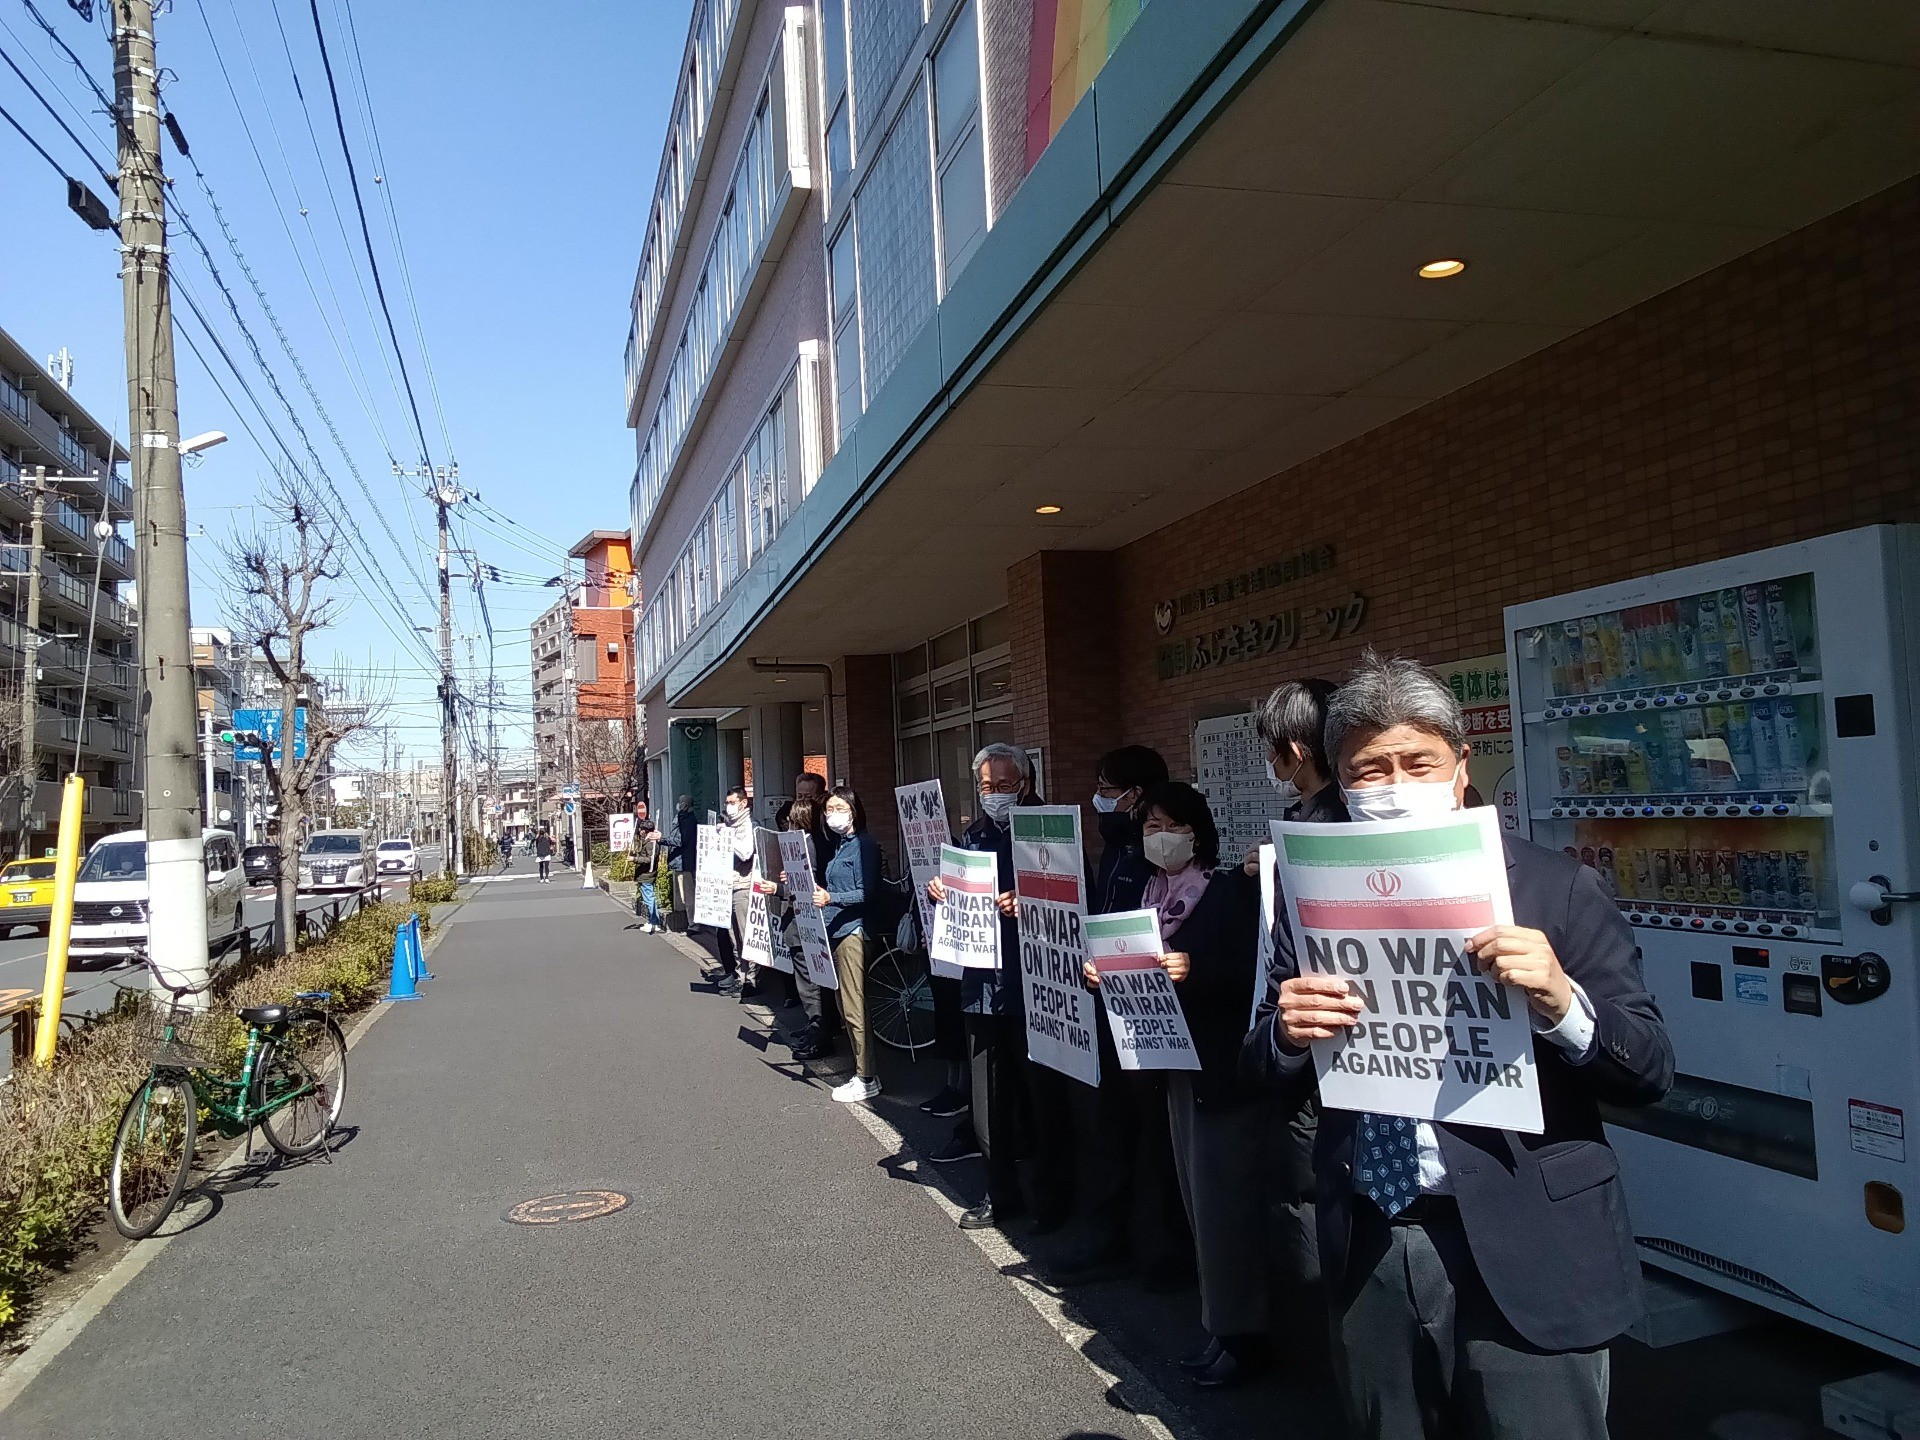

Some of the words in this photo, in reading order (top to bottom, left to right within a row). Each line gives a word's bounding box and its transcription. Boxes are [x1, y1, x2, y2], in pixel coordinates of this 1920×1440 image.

[943, 888, 955, 906] NO
[958, 893, 993, 911] WAR
[750, 911, 766, 927] ON
[941, 906, 955, 923] ON
[958, 910, 995, 928] IRAN
[1020, 902, 1040, 938] NO
[1041, 906, 1081, 949] WAR
[938, 936, 970, 952] AGAINST
[972, 944, 996, 954] WAR
[946, 924, 986, 943] PEOPLE
[1023, 941, 1043, 978] ON
[1045, 946, 1086, 990] IRAN
[1305, 937, 1369, 976] NO
[1100, 975, 1126, 995] NO
[1125, 972, 1170, 994] WAR
[1032, 982, 1080, 1024] PEOPLE
[1110, 996, 1136, 1016] ON
[1137, 995, 1179, 1015] IRAN
[1346, 980, 1380, 1015] N
[1393, 980, 1512, 1020] IRAN
[1030, 1011, 1066, 1042] AGAINST
[1068, 1024, 1091, 1053] WAR
[1124, 1018, 1178, 1036] PEOPLE
[1121, 1037, 1165, 1051] AGAINST
[1165, 1037, 1191, 1050] WAR
[1346, 1021, 1494, 1059] PEOPLE
[1331, 1051, 1446, 1082] AGAINST
[1454, 1060, 1524, 1089] WAR
